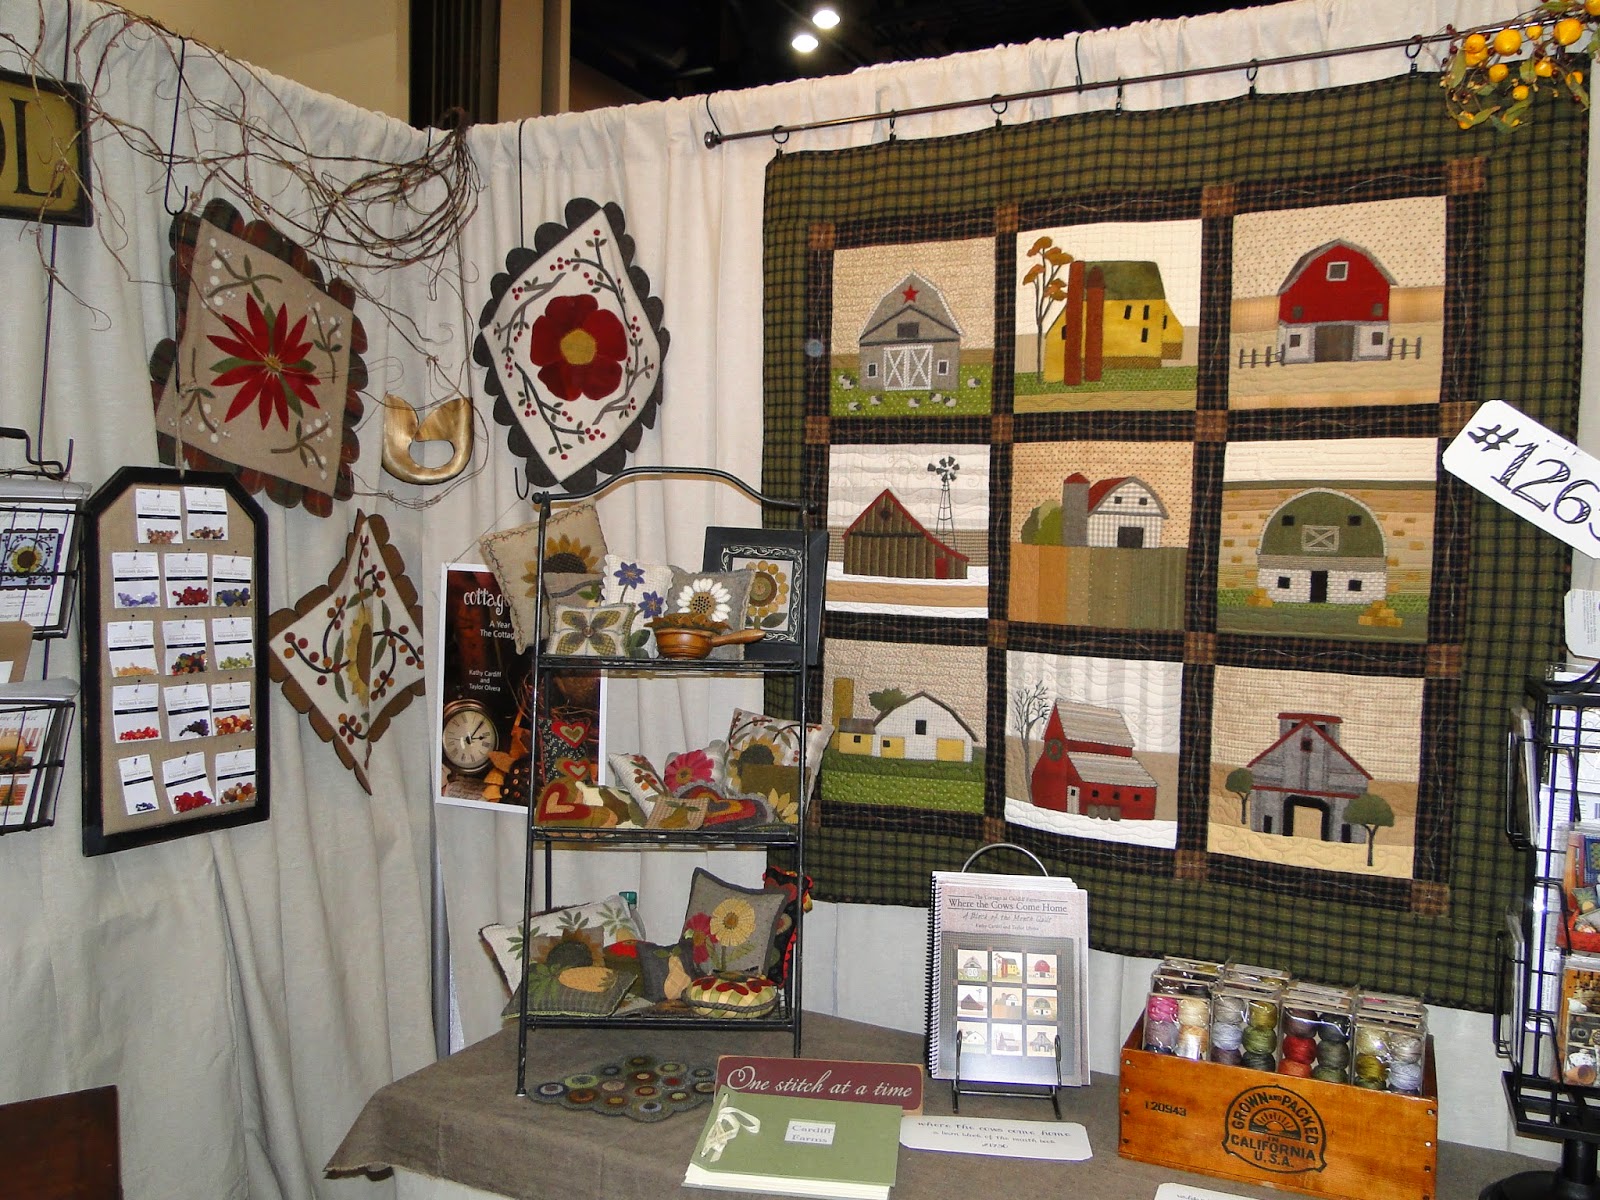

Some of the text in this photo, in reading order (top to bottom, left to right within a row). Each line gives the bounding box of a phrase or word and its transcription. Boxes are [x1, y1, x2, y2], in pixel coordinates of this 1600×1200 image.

[0, 97, 65, 199] L
[1467, 424, 1600, 543] #126
[489, 620, 511, 629] A Year
[480, 629, 492, 638] The
[469, 669, 502, 678] Kathy Cardiff
[484, 684, 501, 692] Olvera
[949, 897, 1067, 913] Where the Cows Come Home
[727, 1065, 913, 1098] One stitch at a time
[1145, 1100, 1187, 1117] 120943
[1231, 1092, 1269, 1130] GROWN
[1281, 1095, 1319, 1145] PACKED
[791, 1124, 834, 1135] Cardiff
[791, 1134, 828, 1144] Farms
[1231, 1134, 1316, 1161] CALIFORNIA
[1254, 1151, 1295, 1168] U.S.A.
